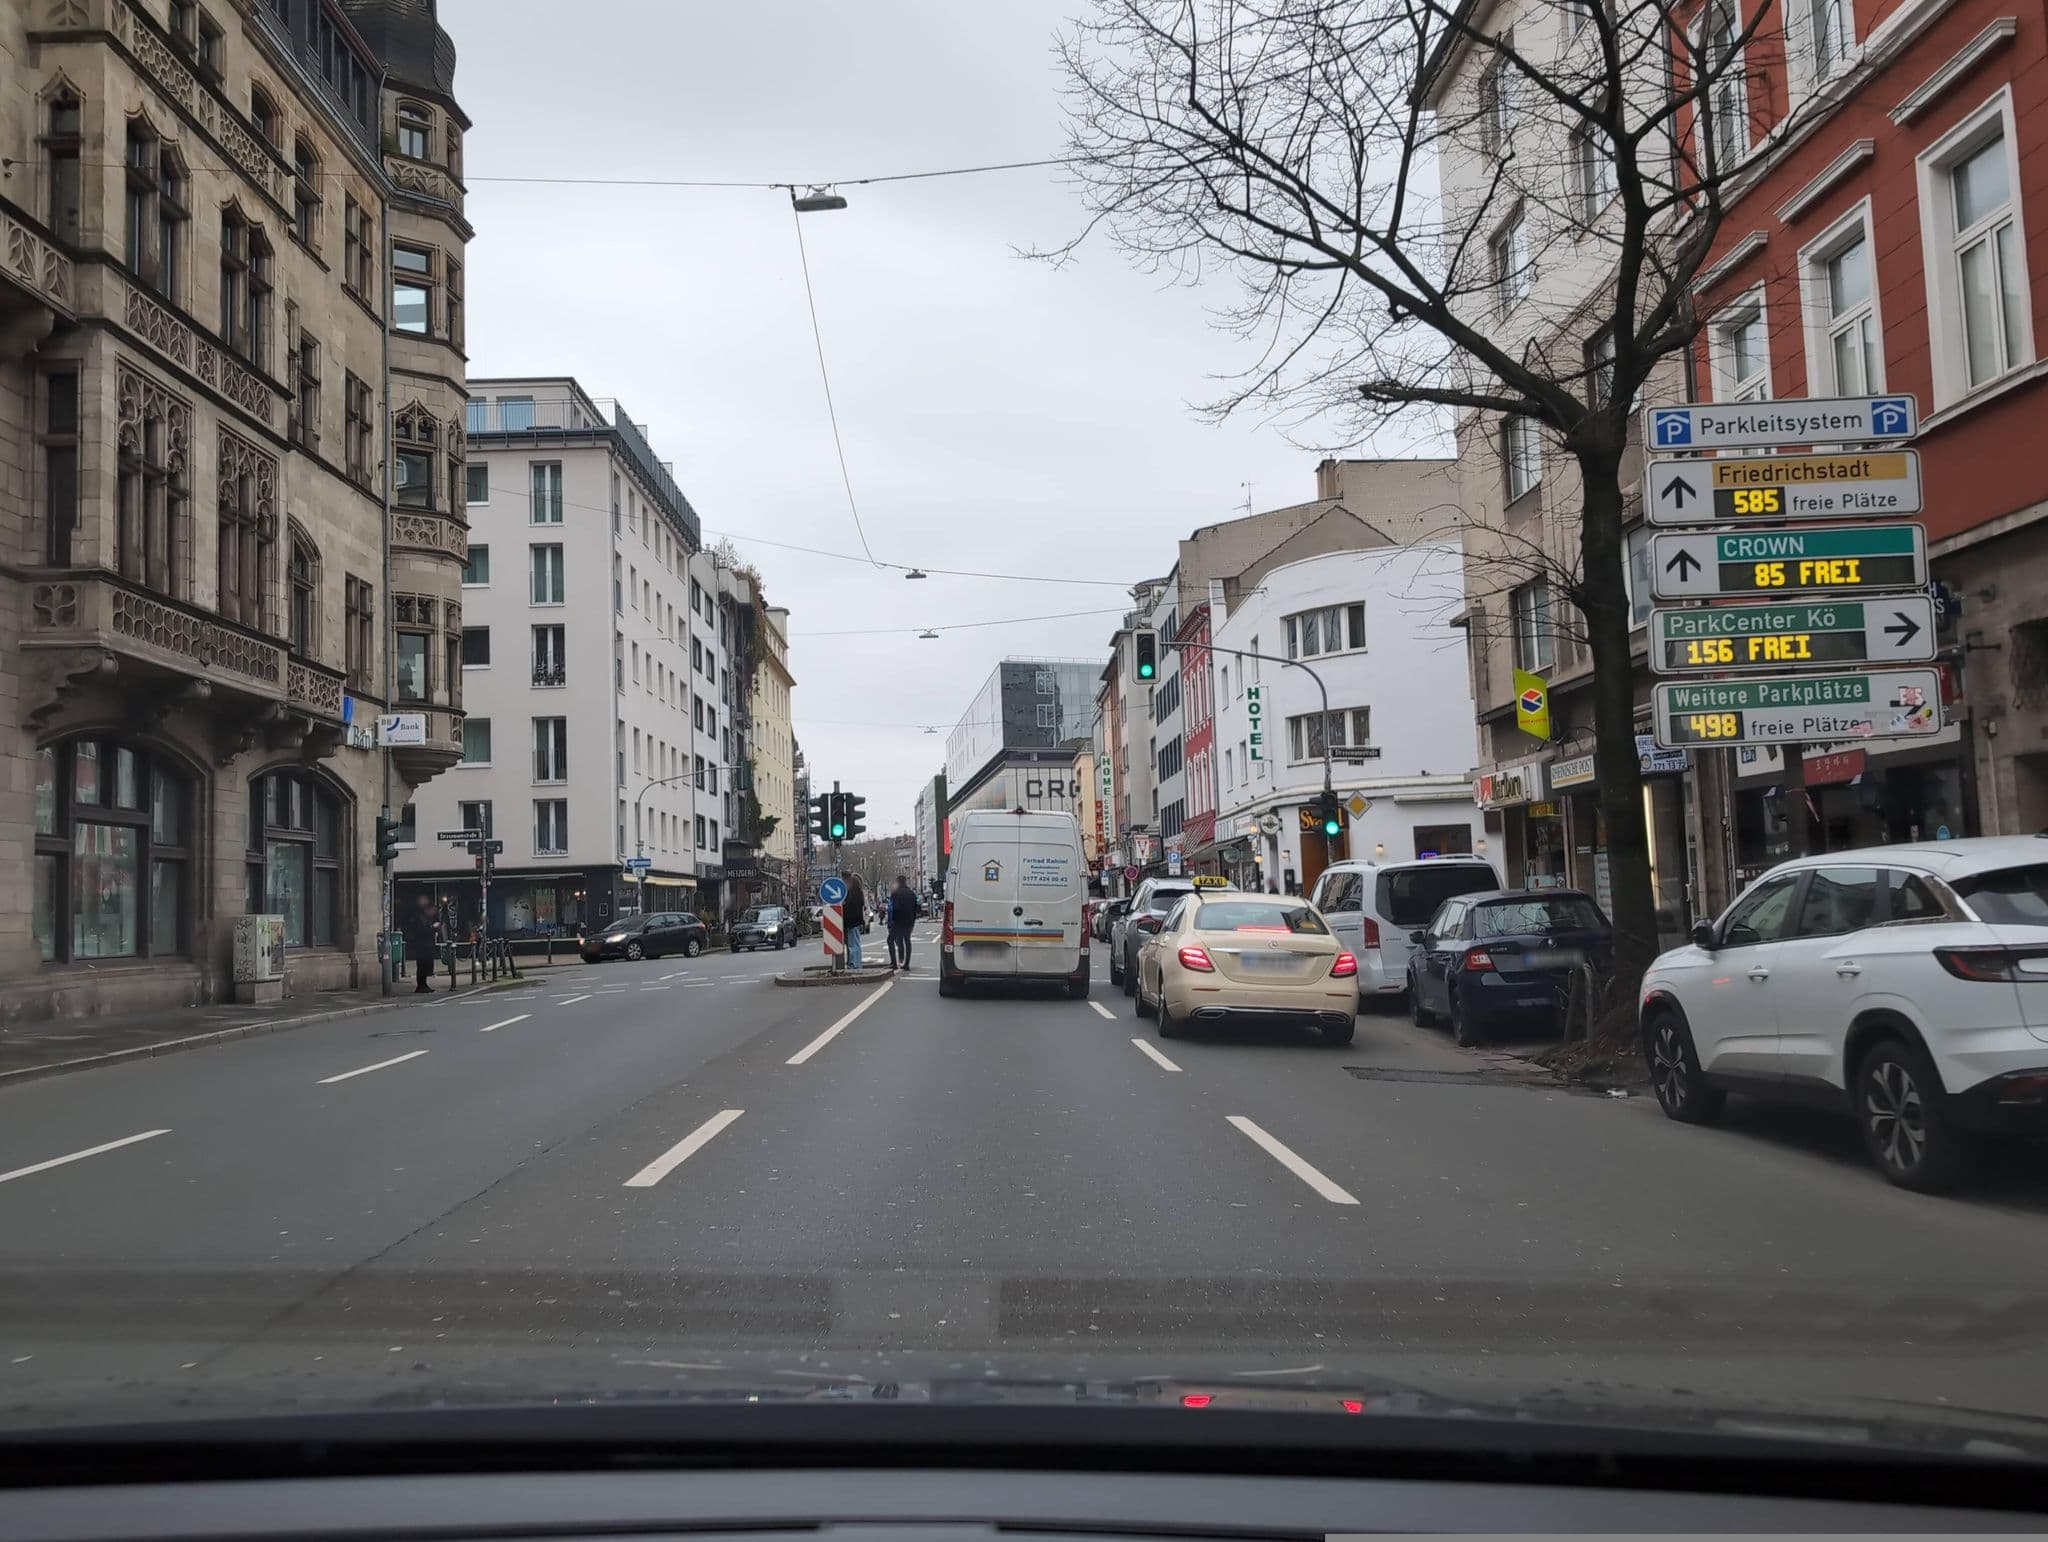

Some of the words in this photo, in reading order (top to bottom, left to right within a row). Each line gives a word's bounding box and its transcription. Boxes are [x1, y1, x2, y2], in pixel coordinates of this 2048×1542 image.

[1700, 413, 1863, 435] Parkleitsystem
[1718, 460, 1870, 483] Friedrichstadt
[1733, 489, 1780, 514] 585
[1792, 495, 1834, 511] freie
[1842, 492, 1897, 509] Plätze
[1723, 536, 1804, 557] CROWN
[1754, 562, 1786, 587] 85
[1799, 559, 1861, 585] FREI
[1670, 612, 1796, 634] ParkCenter
[1807, 607, 1836, 627] Kö
[1687, 638, 1734, 664] 156
[1748, 634, 1811, 660] FREI
[1675, 688, 1748, 708] Weitere
[1758, 683, 1863, 705] Parkplätze
[1247, 687, 1264, 761] HOTEL
[1690, 713, 1737, 738] 498
[1751, 718, 1794, 736] freie
[1802, 717, 1860, 733] Plätze
[1102, 757, 1111, 796] HOME
[1200, 876, 1225, 885] TAXI
